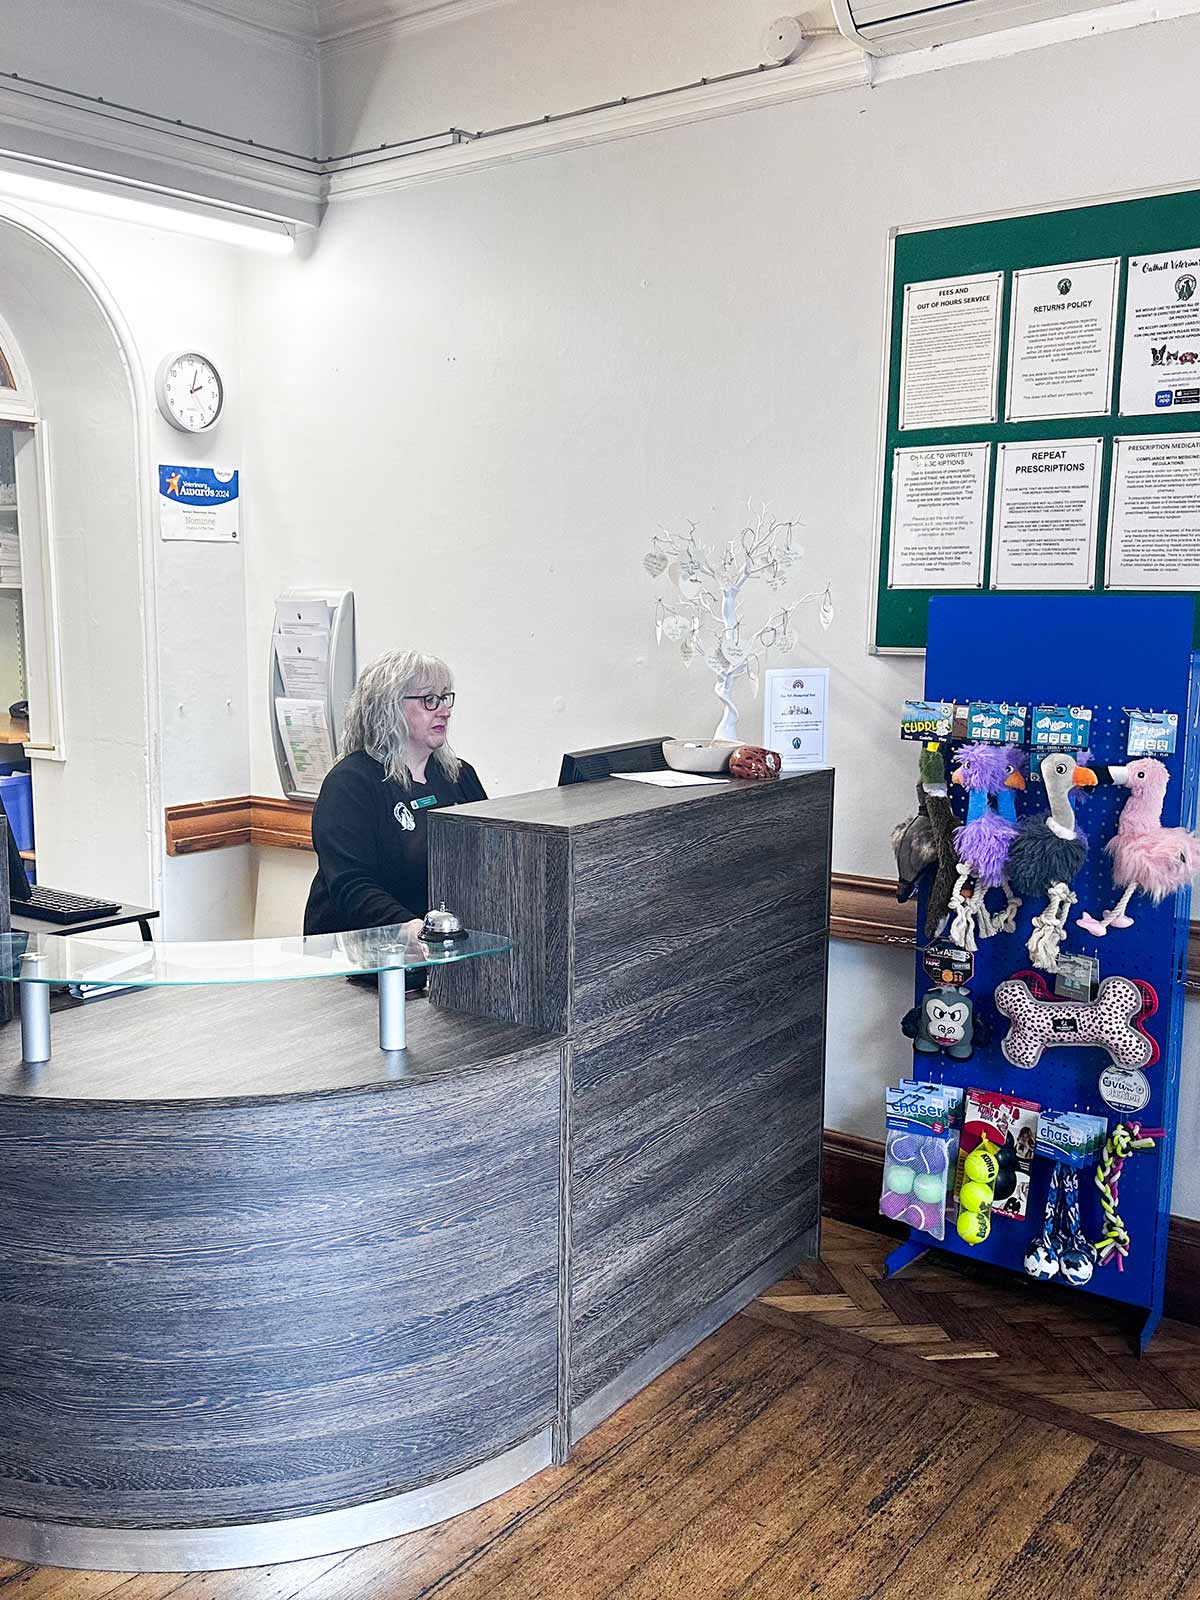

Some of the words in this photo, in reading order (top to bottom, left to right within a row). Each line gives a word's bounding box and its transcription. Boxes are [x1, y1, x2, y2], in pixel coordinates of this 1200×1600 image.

[940, 299, 962, 307] HOURS
[964, 295, 990, 304] SERVICE
[1034, 304, 1065, 312] RETURNS
[1067, 300, 1092, 309] POLICY
[1032, 451, 1066, 460] REPEAT
[1015, 463, 1085, 474] PRESCRIPTIONS
[180, 485, 214, 496] Awards
[892, 1100, 945, 1117] chaser
[981, 1154, 995, 1172] KONG
